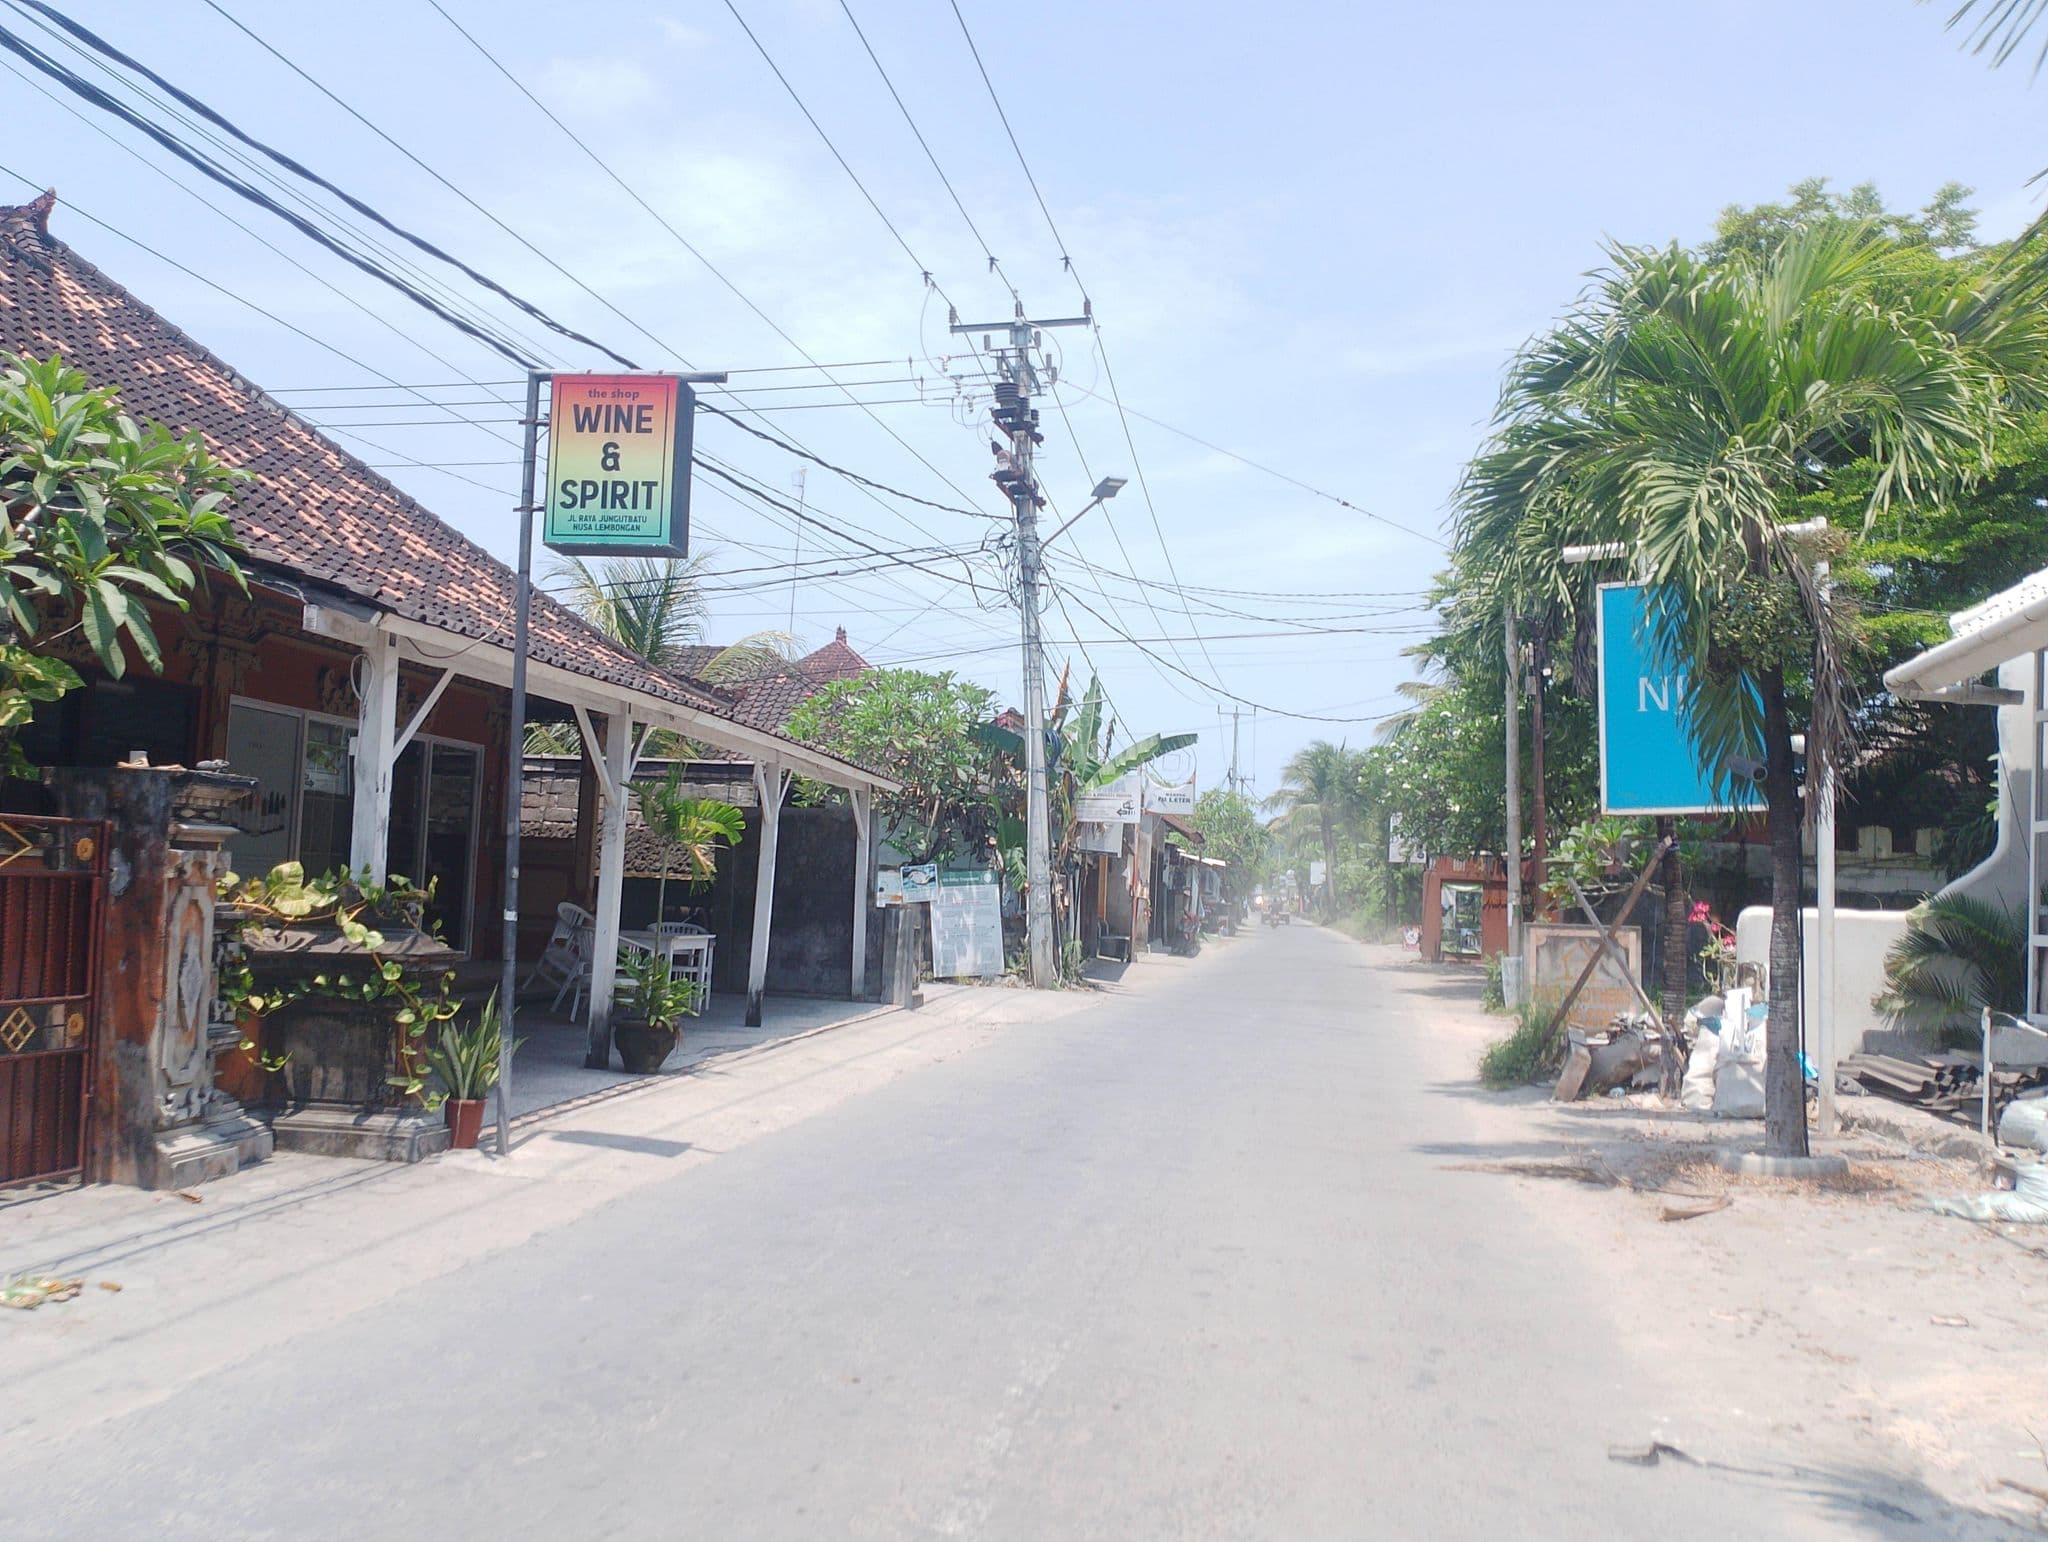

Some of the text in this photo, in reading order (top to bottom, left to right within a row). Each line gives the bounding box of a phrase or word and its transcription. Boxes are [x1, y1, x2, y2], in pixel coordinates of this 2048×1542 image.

[588, 389, 639, 401] the shop
[573, 404, 654, 434] WINE
[600, 441, 621, 472] &
[559, 479, 658, 510] SPIRIT
[568, 514, 648, 523] JL RAYA JUNGUTBATU
[573, 523, 641, 532] NUSA LEMBONGAN
